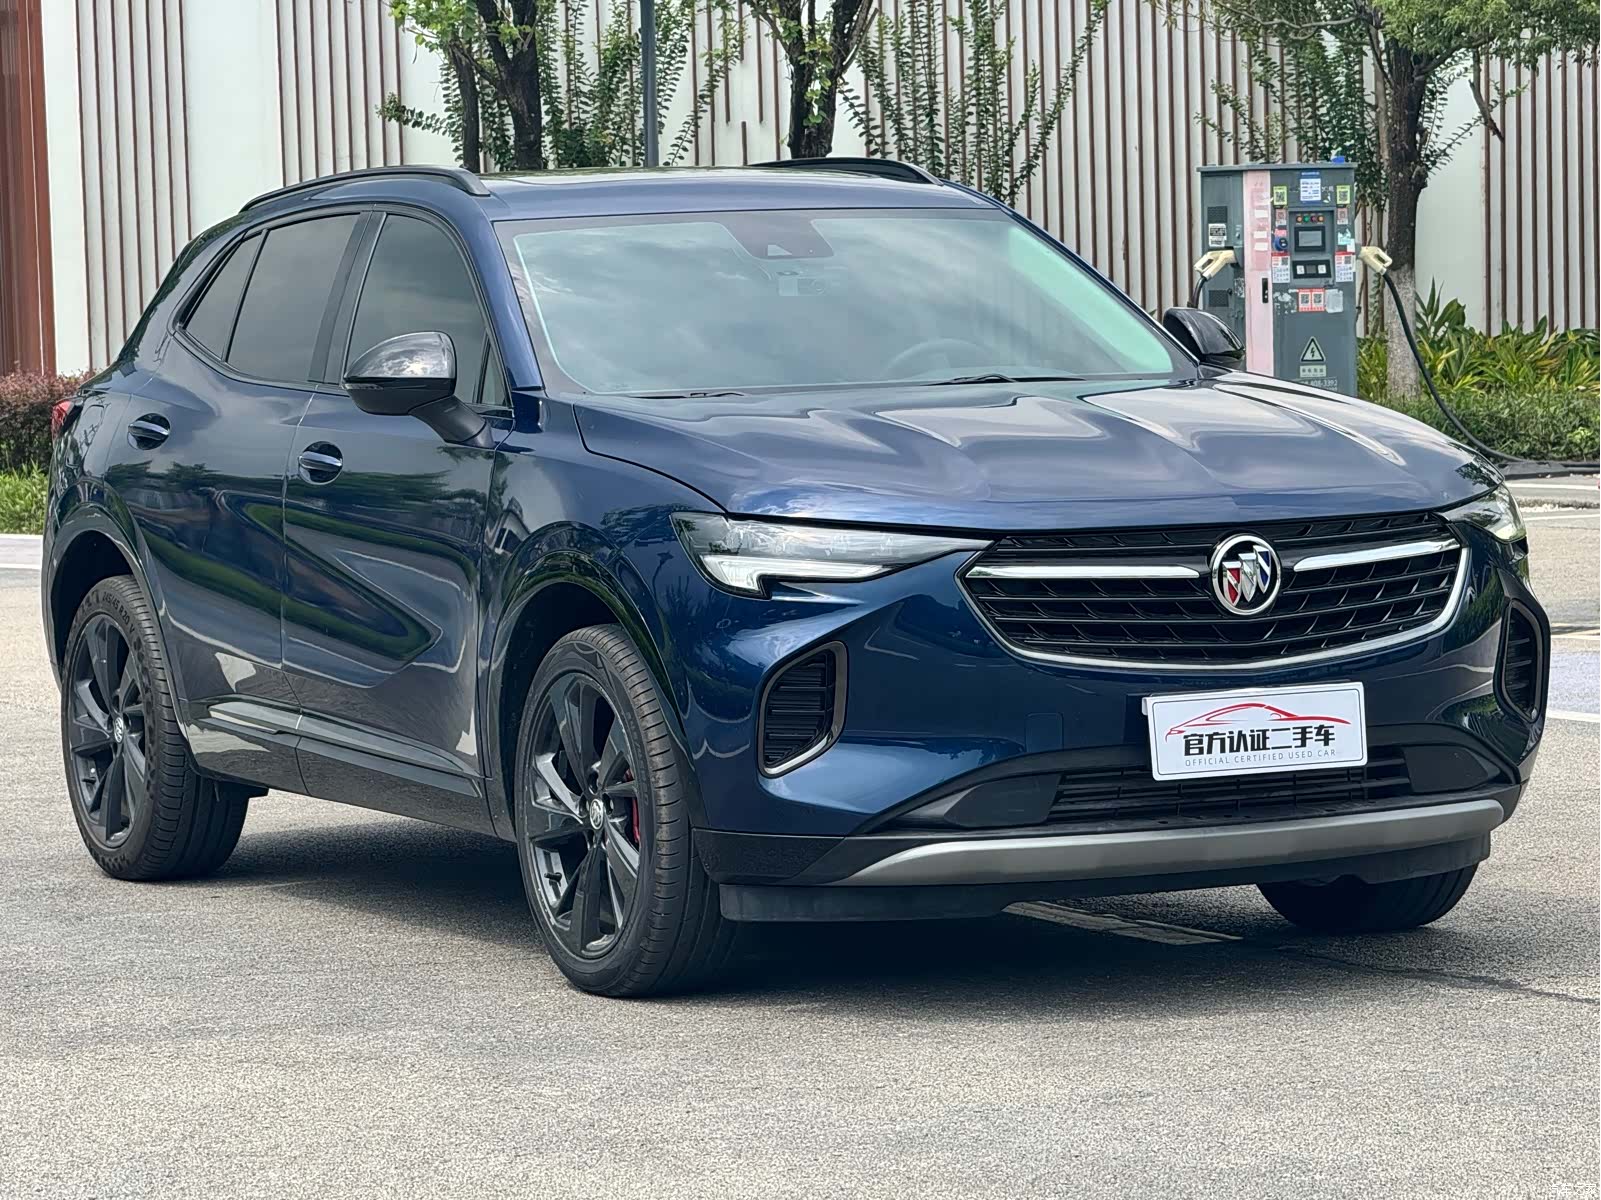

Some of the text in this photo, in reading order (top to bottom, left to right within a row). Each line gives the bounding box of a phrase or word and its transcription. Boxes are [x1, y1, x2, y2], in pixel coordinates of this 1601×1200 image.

[1183, 724, 1336, 757] 官方认证二手车
[1185, 747, 1336, 767] OFFICIAL CERTIFIED USED CAR
